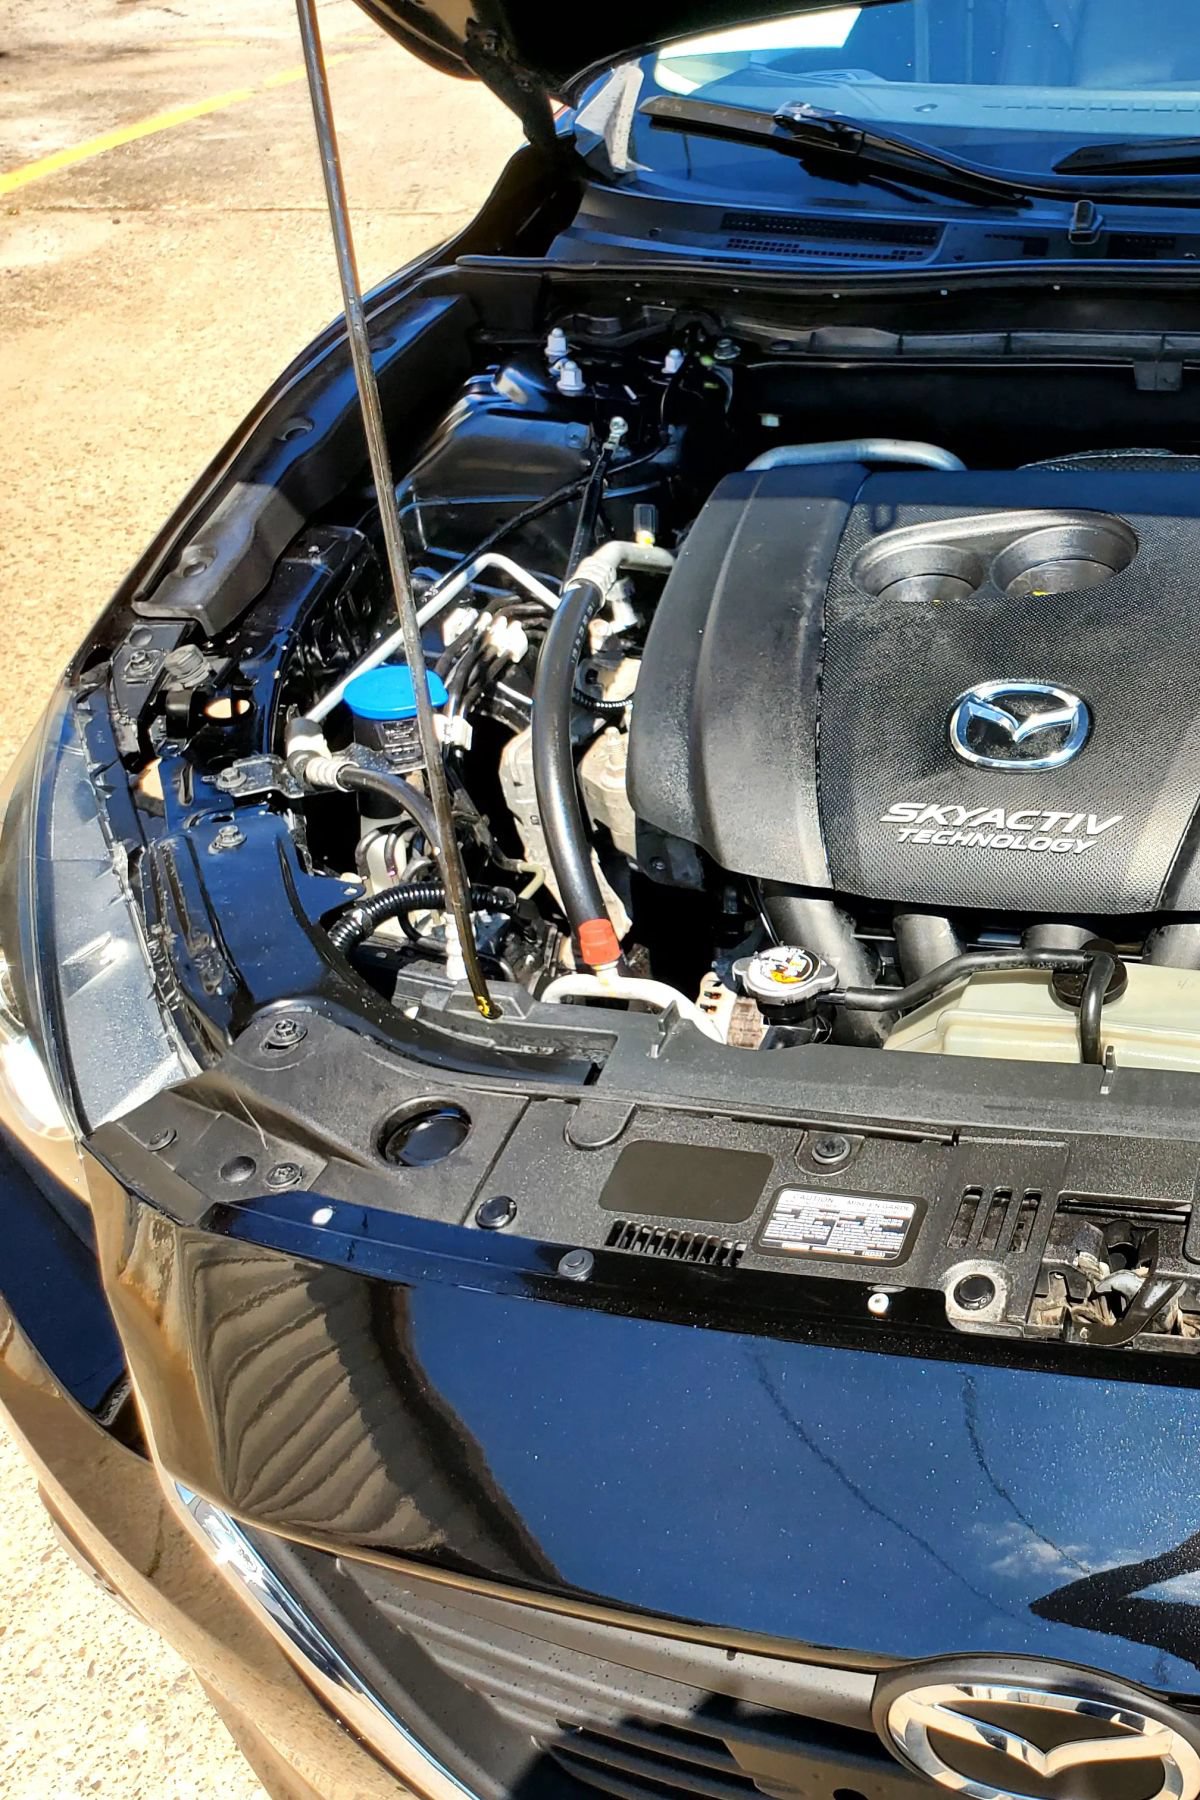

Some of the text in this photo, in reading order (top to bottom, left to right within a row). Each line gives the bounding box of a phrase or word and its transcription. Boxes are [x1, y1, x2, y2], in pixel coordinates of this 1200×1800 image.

[879, 801, 1125, 836] SKYACTIV
[896, 827, 1099, 855] TECHNOLOGY
[793, 1193, 834, 1204] CAUTION
